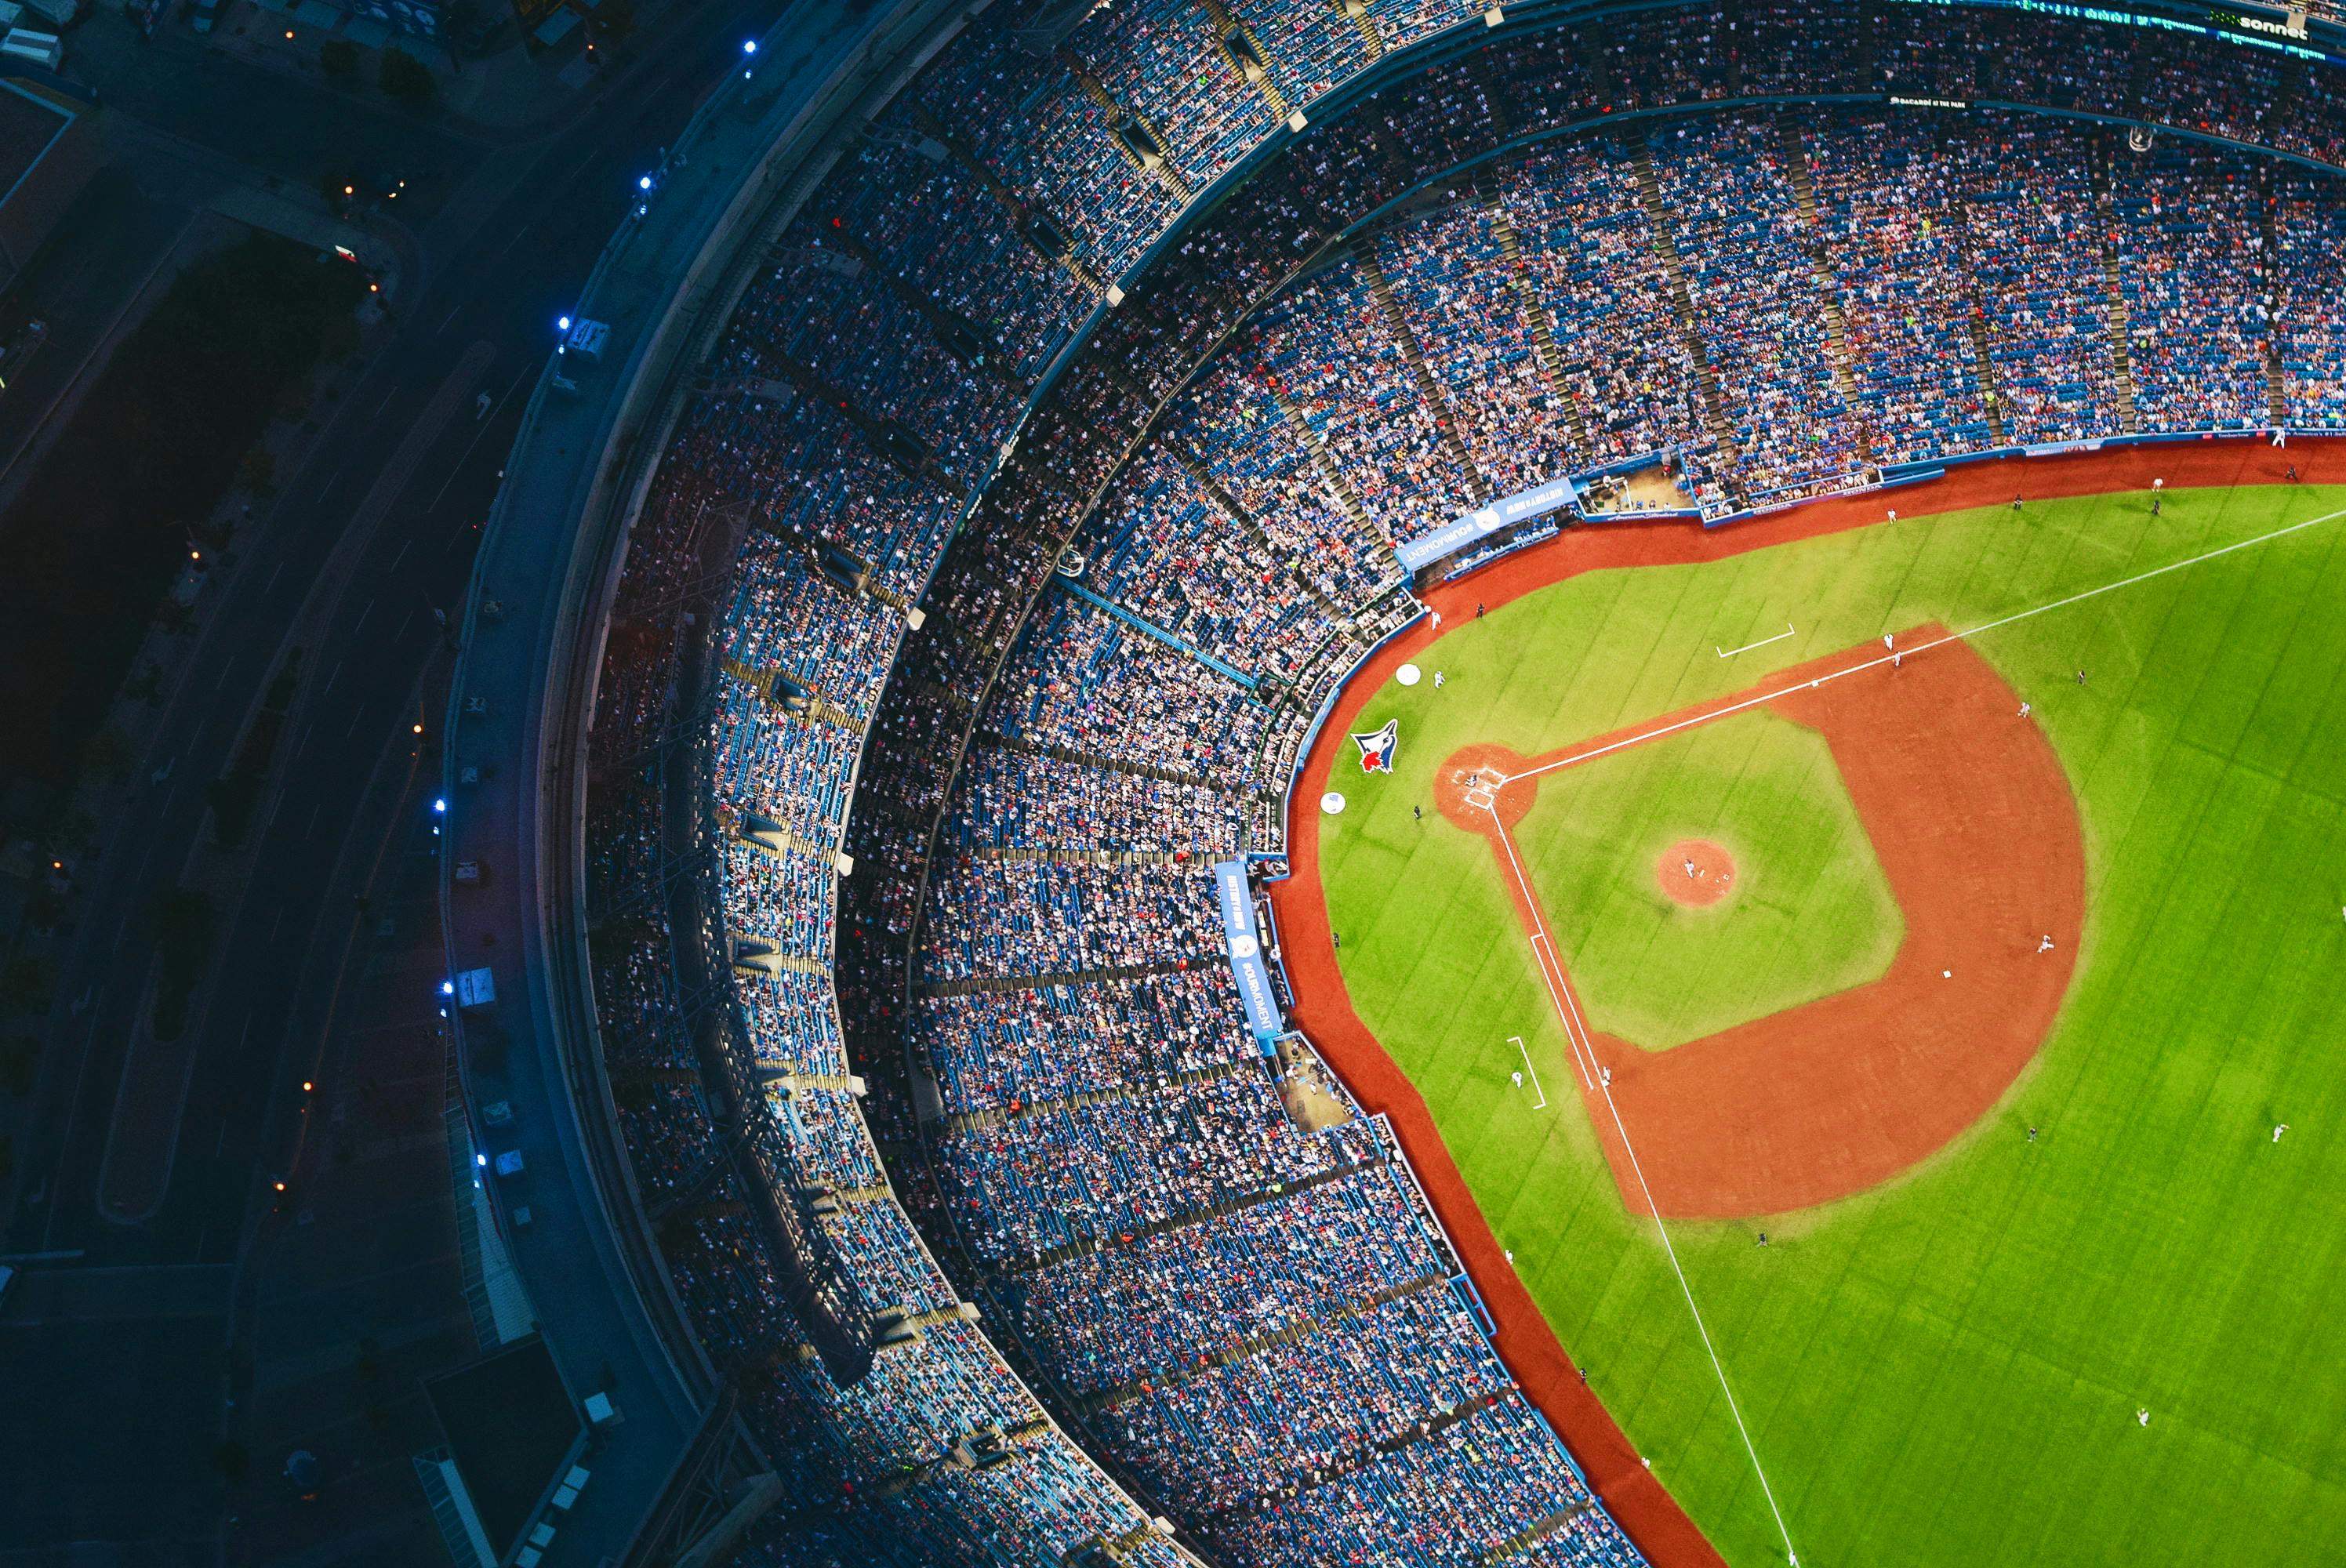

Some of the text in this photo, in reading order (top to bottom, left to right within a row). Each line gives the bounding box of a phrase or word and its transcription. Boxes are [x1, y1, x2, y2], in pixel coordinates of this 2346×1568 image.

[2240, 16, 2308, 40] sonnet
[1843, 484, 1882, 496] HONDA
[1752, 503, 1792, 515] HONDA
[1406, 523, 1474, 562] #OURMOMENT
[1242, 962, 1273, 1029] #OURMOMENT
